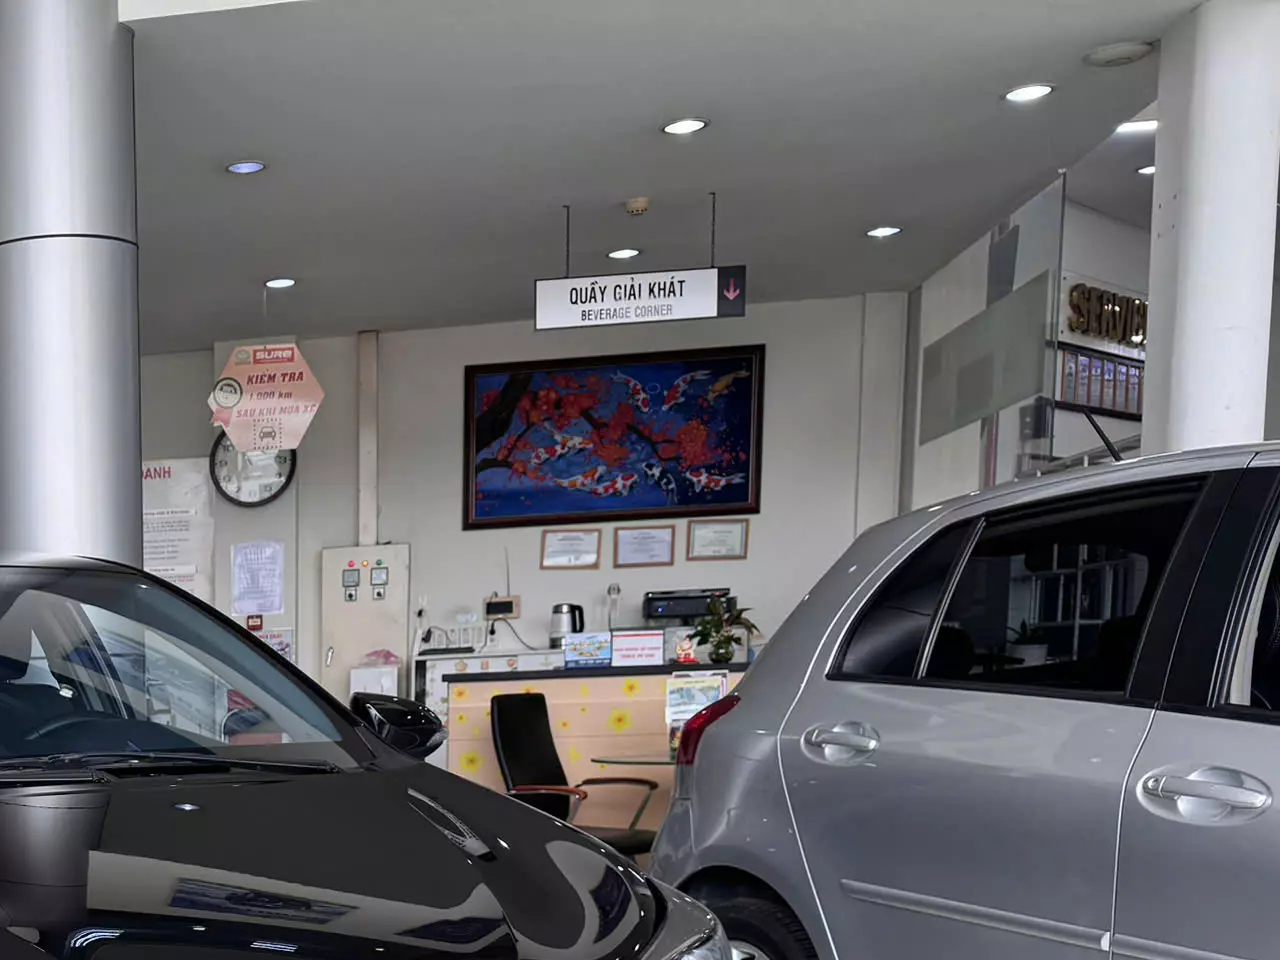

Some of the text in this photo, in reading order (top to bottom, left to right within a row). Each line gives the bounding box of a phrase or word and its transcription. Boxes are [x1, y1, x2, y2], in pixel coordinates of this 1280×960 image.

[570, 276, 686, 305] QUẦY GIẢI KHÁT
[581, 304, 673, 321] BEVERAGE CORNER
[277, 391, 293, 399] km
[258, 406, 276, 417] KHI
[142, 466, 171, 480] ANH
